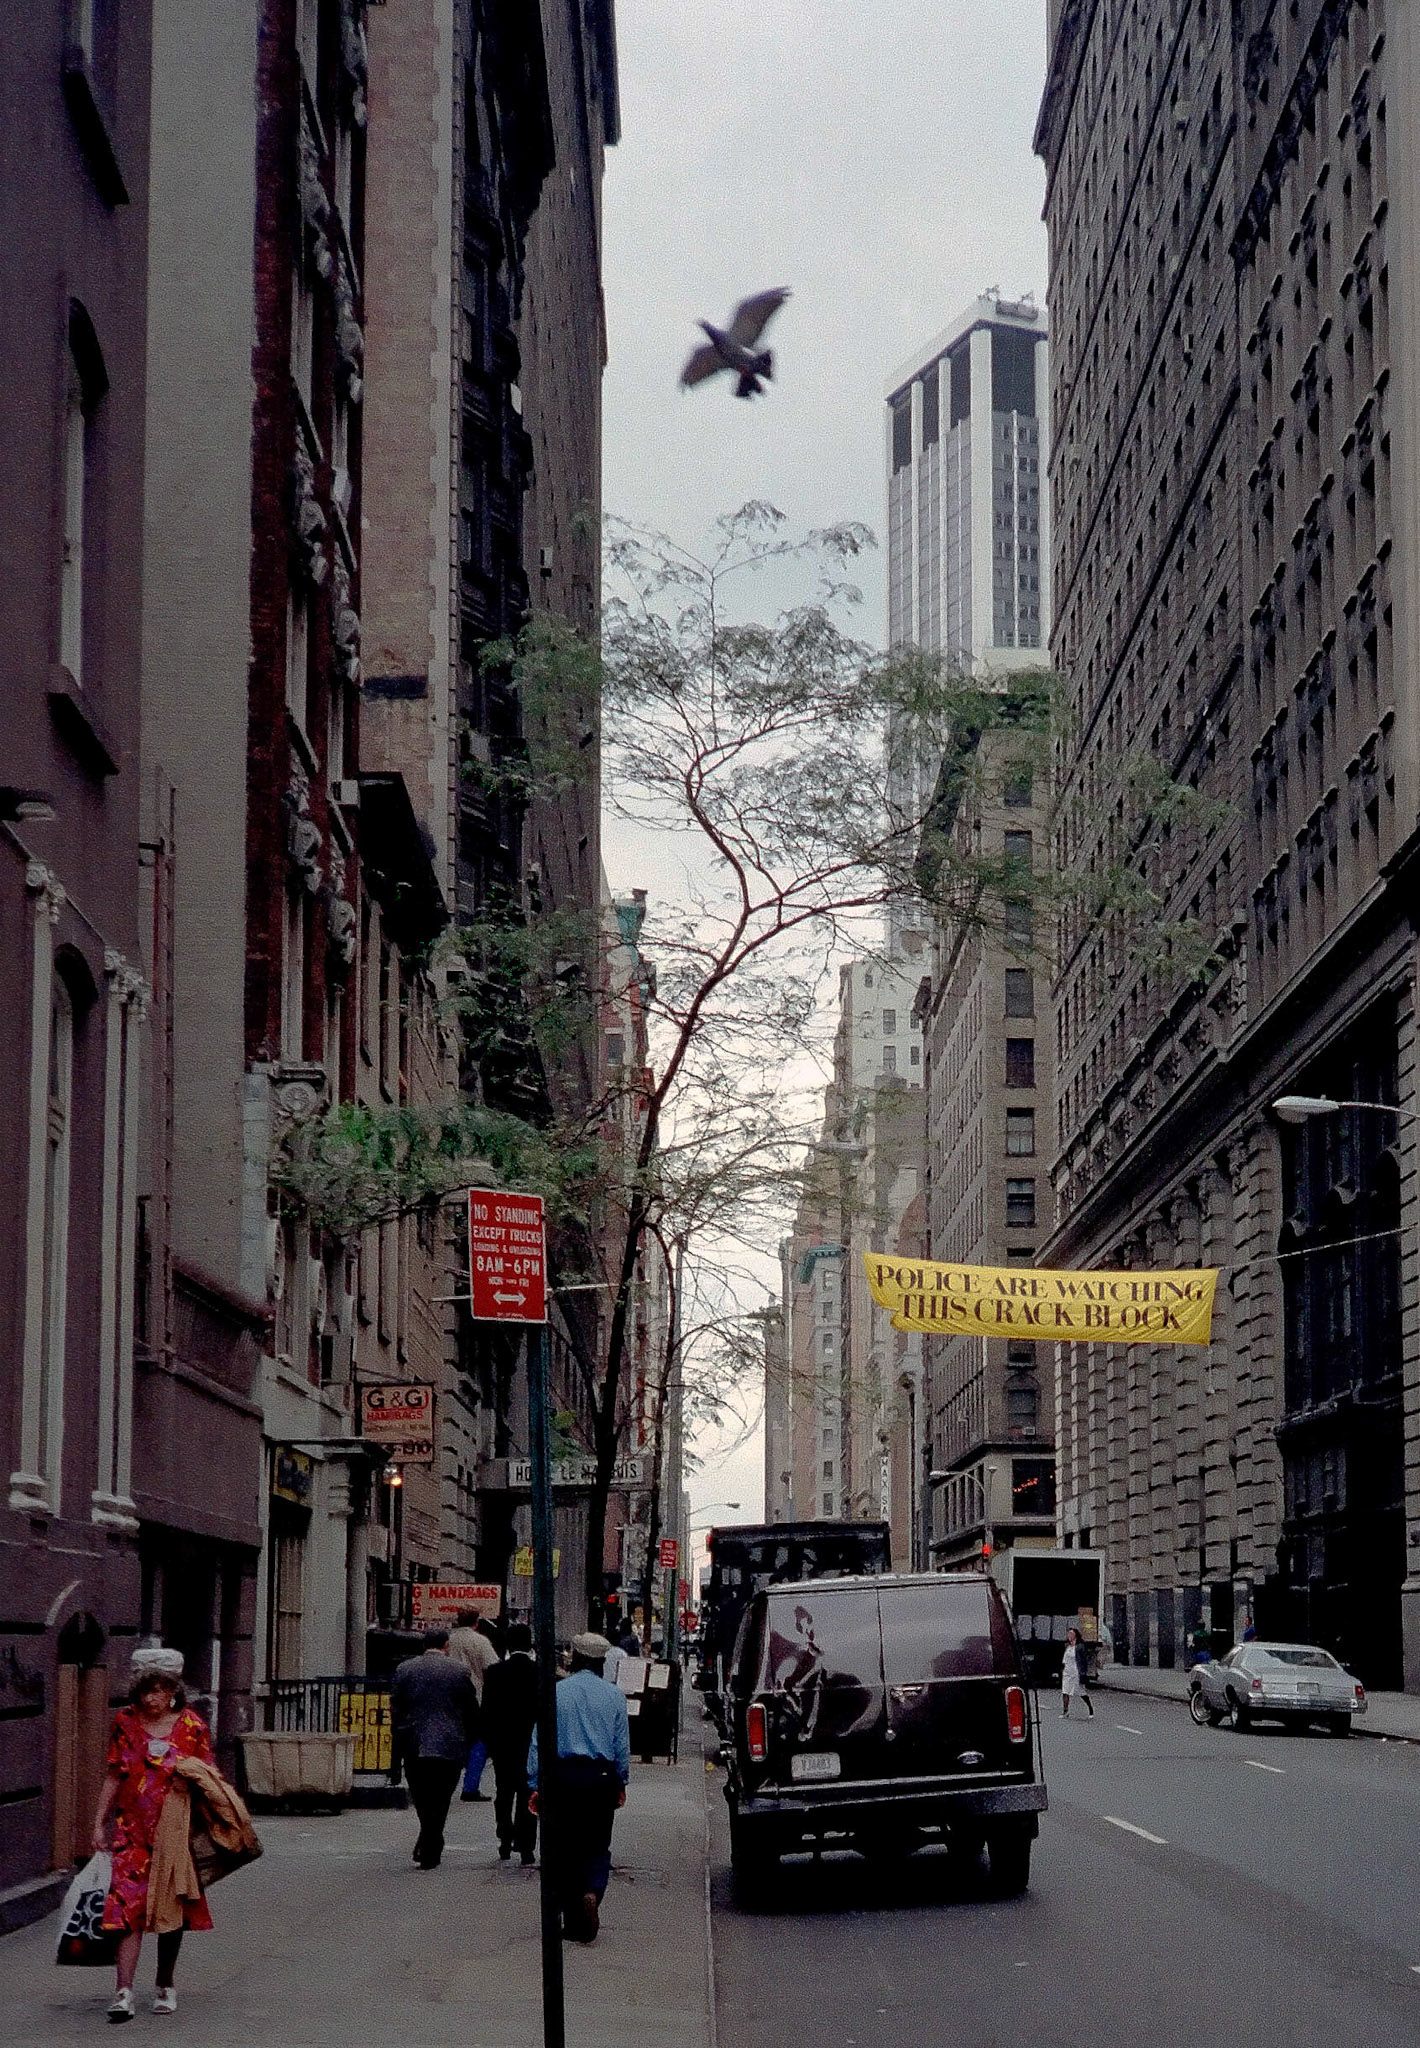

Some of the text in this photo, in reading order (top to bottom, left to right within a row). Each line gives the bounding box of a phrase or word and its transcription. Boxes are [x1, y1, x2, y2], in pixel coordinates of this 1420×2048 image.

[473, 1204, 540, 1226] NO STANDING
[473, 1226, 541, 1244] EXCEPT TRUCKS
[876, 1264, 1204, 1302] POLICE ARE WATCHING
[898, 1293, 1183, 1330] THIS CRACK BLOCK
[429, 1586, 498, 1600] HANDBAGS
[342, 1708, 391, 1726] SHOE
